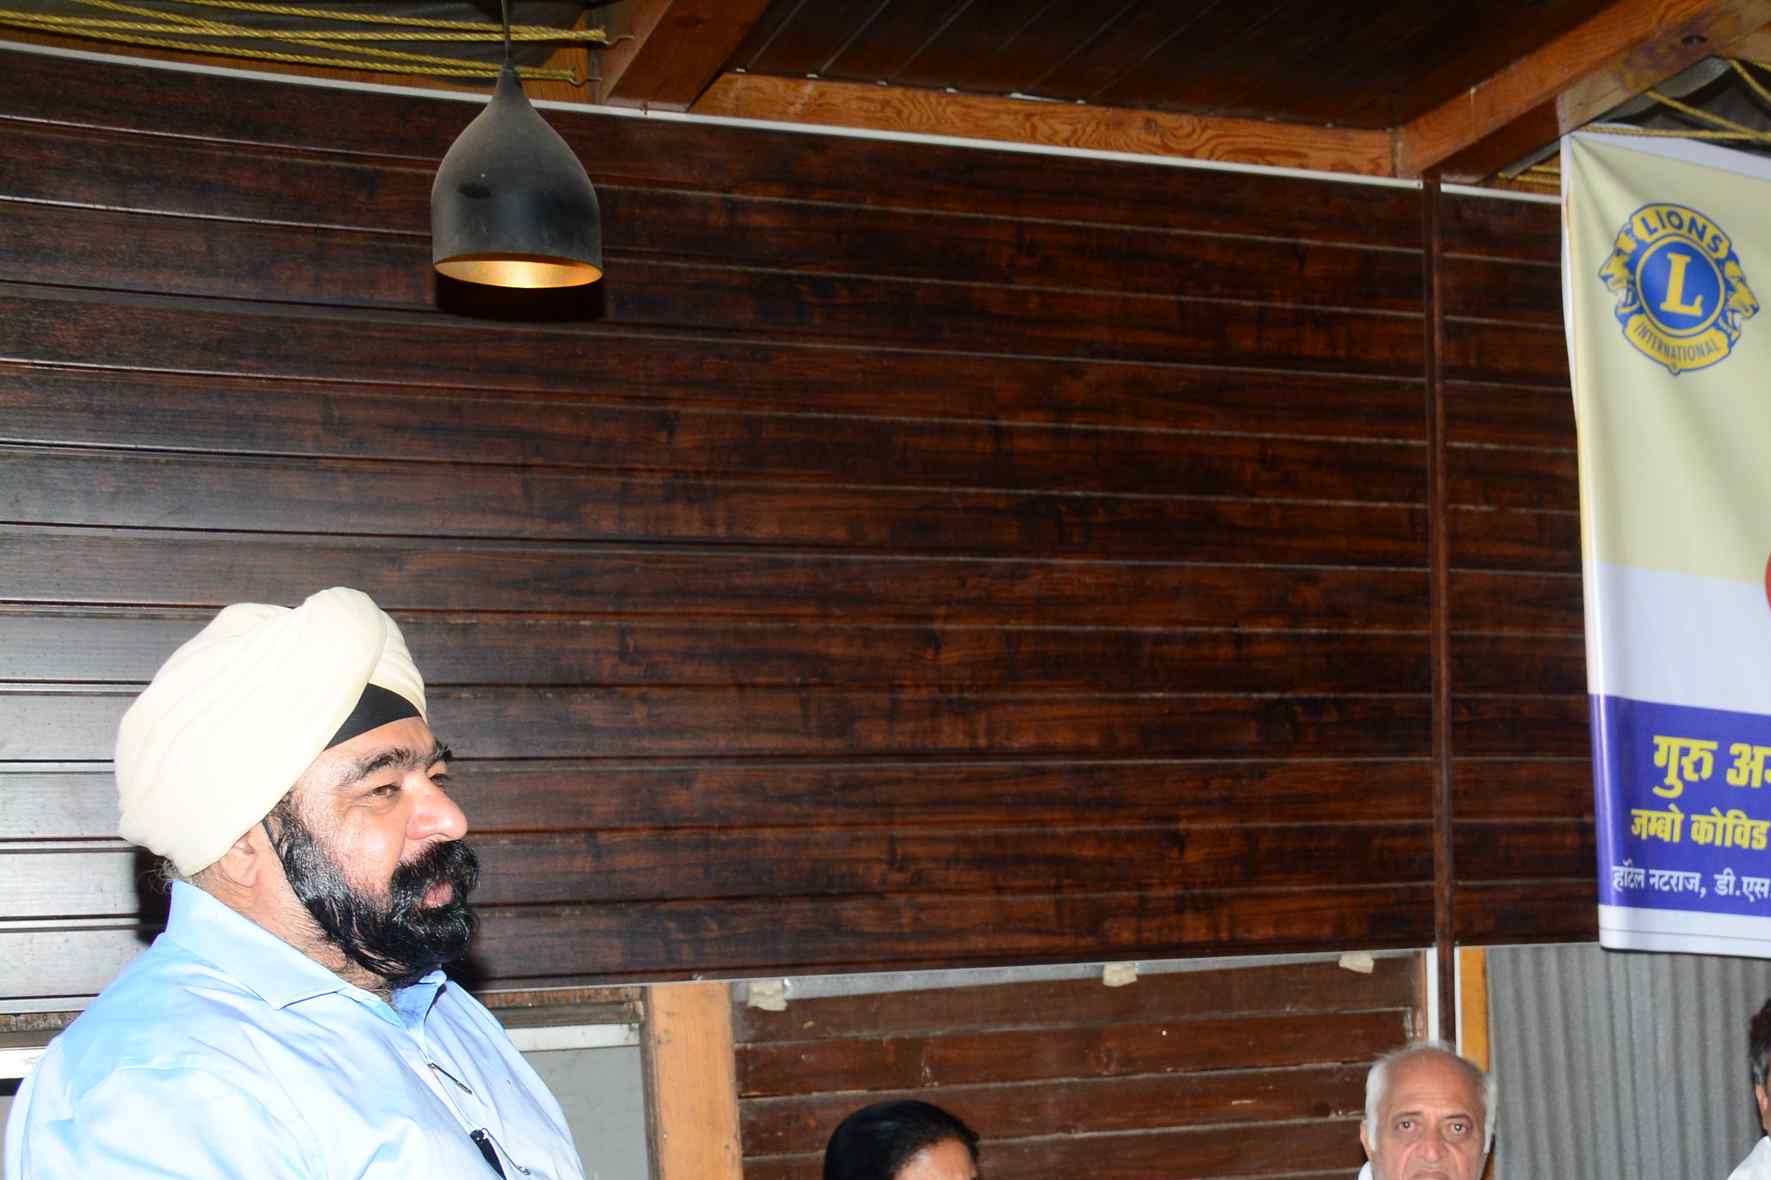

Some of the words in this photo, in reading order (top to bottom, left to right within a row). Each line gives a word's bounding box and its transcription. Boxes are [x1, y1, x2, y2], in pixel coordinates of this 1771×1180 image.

[1639, 209, 1724, 254] LIONS
[1659, 252, 1703, 317] L
[1633, 319, 1721, 364] INTERNATIONAL
[1652, 735, 1719, 799] गुरु
[1690, 806, 1770, 850] कोविड
[1648, 868, 1707, 898] नटराज,
